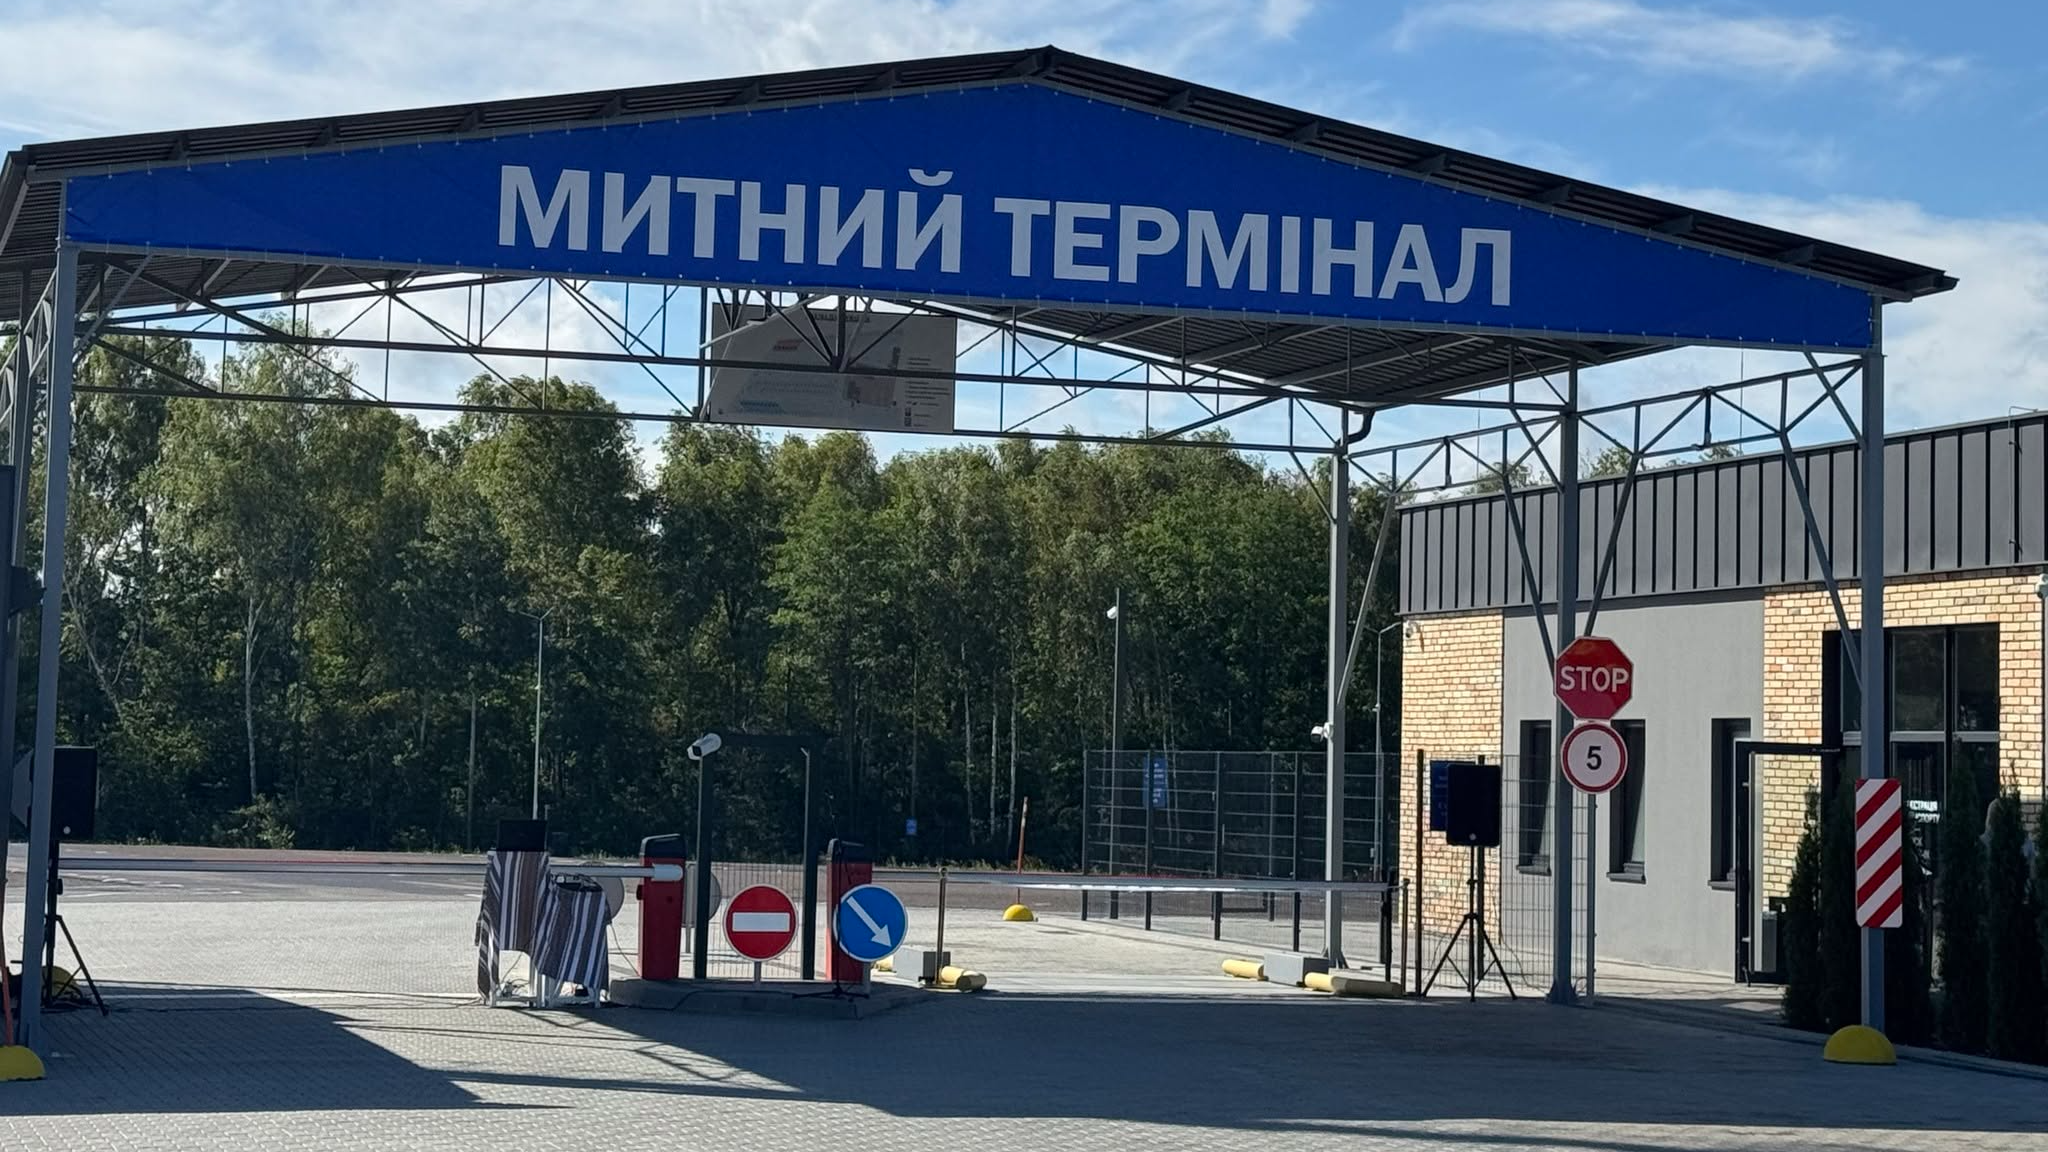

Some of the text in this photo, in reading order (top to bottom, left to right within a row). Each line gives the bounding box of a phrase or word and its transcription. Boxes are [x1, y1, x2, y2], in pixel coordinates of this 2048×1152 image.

[498, 165, 1512, 306] МИТНИЙ ТЕРМІНАЛ
[1559, 665, 1630, 693] STOP
[1586, 745, 1603, 771] 5
